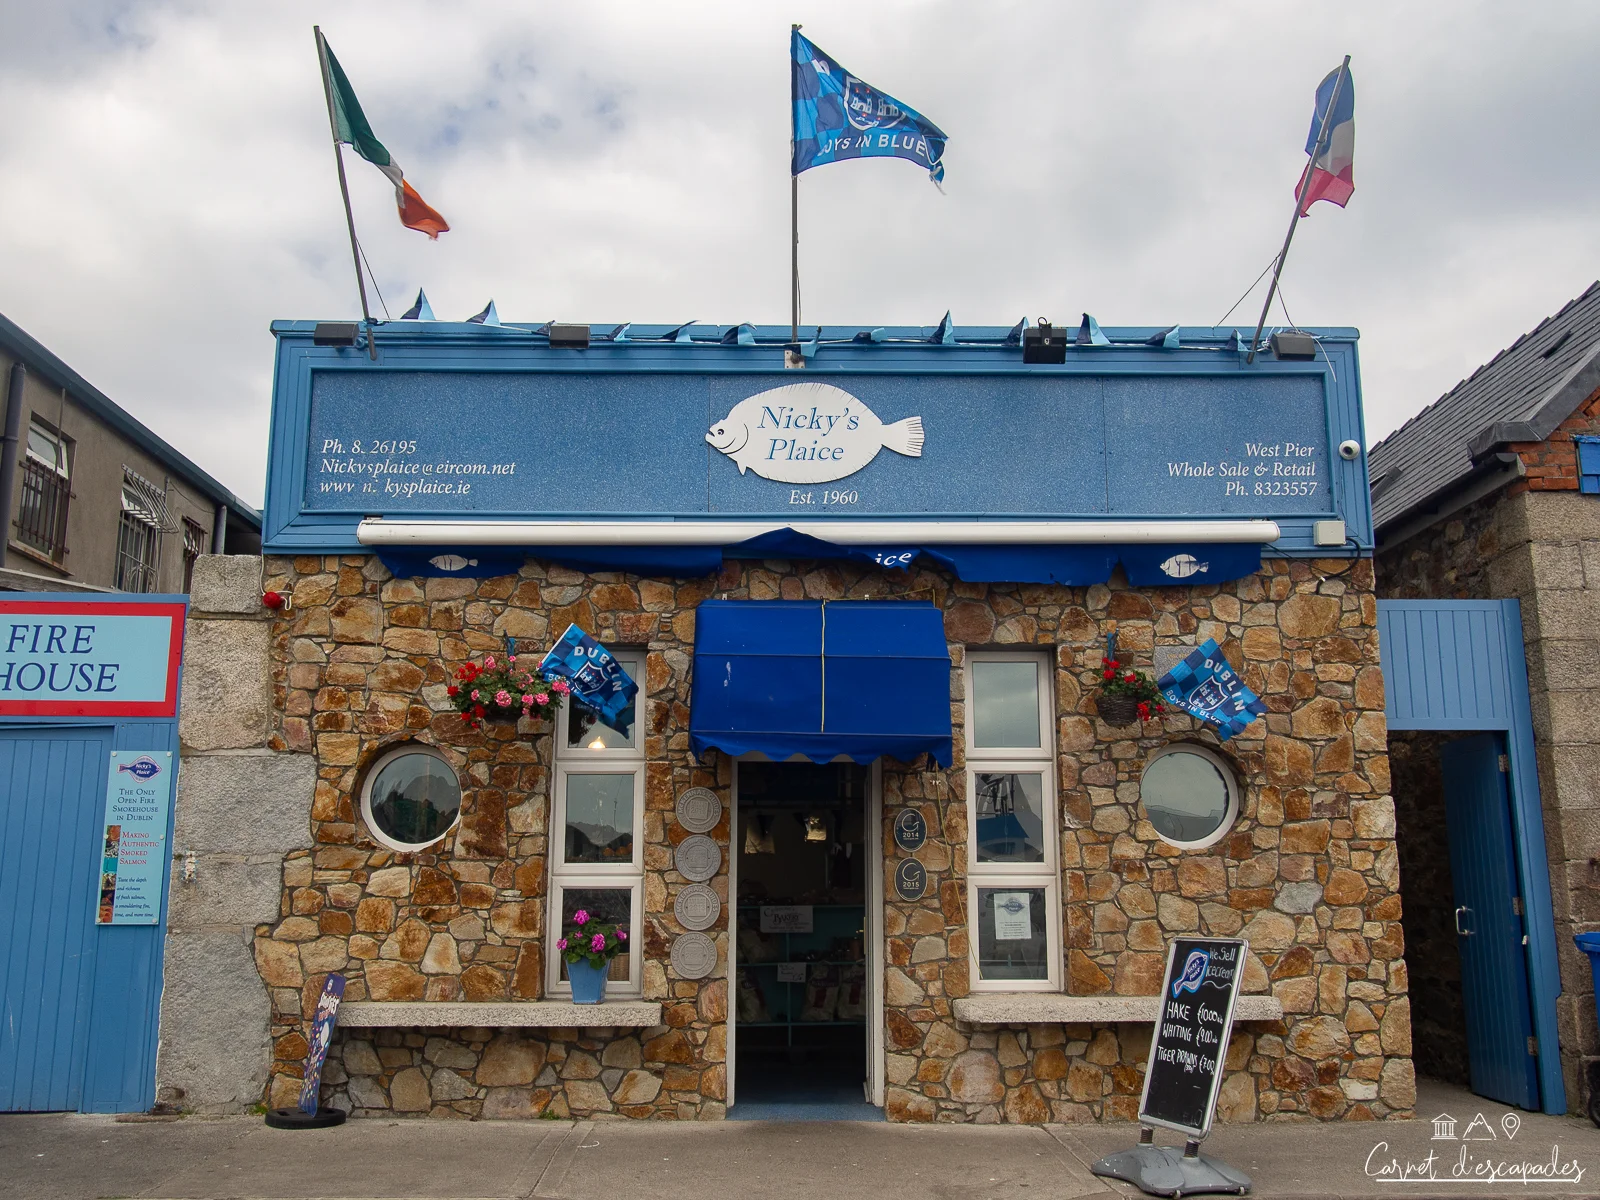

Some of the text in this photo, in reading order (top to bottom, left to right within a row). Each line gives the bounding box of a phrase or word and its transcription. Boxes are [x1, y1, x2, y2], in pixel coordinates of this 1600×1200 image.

[856, 134, 872, 148] IN
[878, 134, 926, 156] BLUE
[757, 406, 860, 436] Nicky's
[322, 439, 346, 454] Ph.
[764, 438, 844, 461] Plaice
[1245, 442, 1314, 457] West Pier
[1167, 462, 1316, 477] Whole Sale & Retail
[789, 490, 858, 504] Est. 1960
[1225, 481, 1318, 496] Ph. 8323557
[6, 624, 96, 654] FIRE
[0, 662, 120, 692] HOUSE
[574, 646, 622, 692] DUBLIN
[1204, 658, 1245, 711] DUBLIN
[1166, 690, 1186, 707] BOYS
[1219, 947, 1236, 961] Sell
[1167, 1001, 1191, 1021] HAKE
[1163, 1023, 1192, 1042] WHITING
